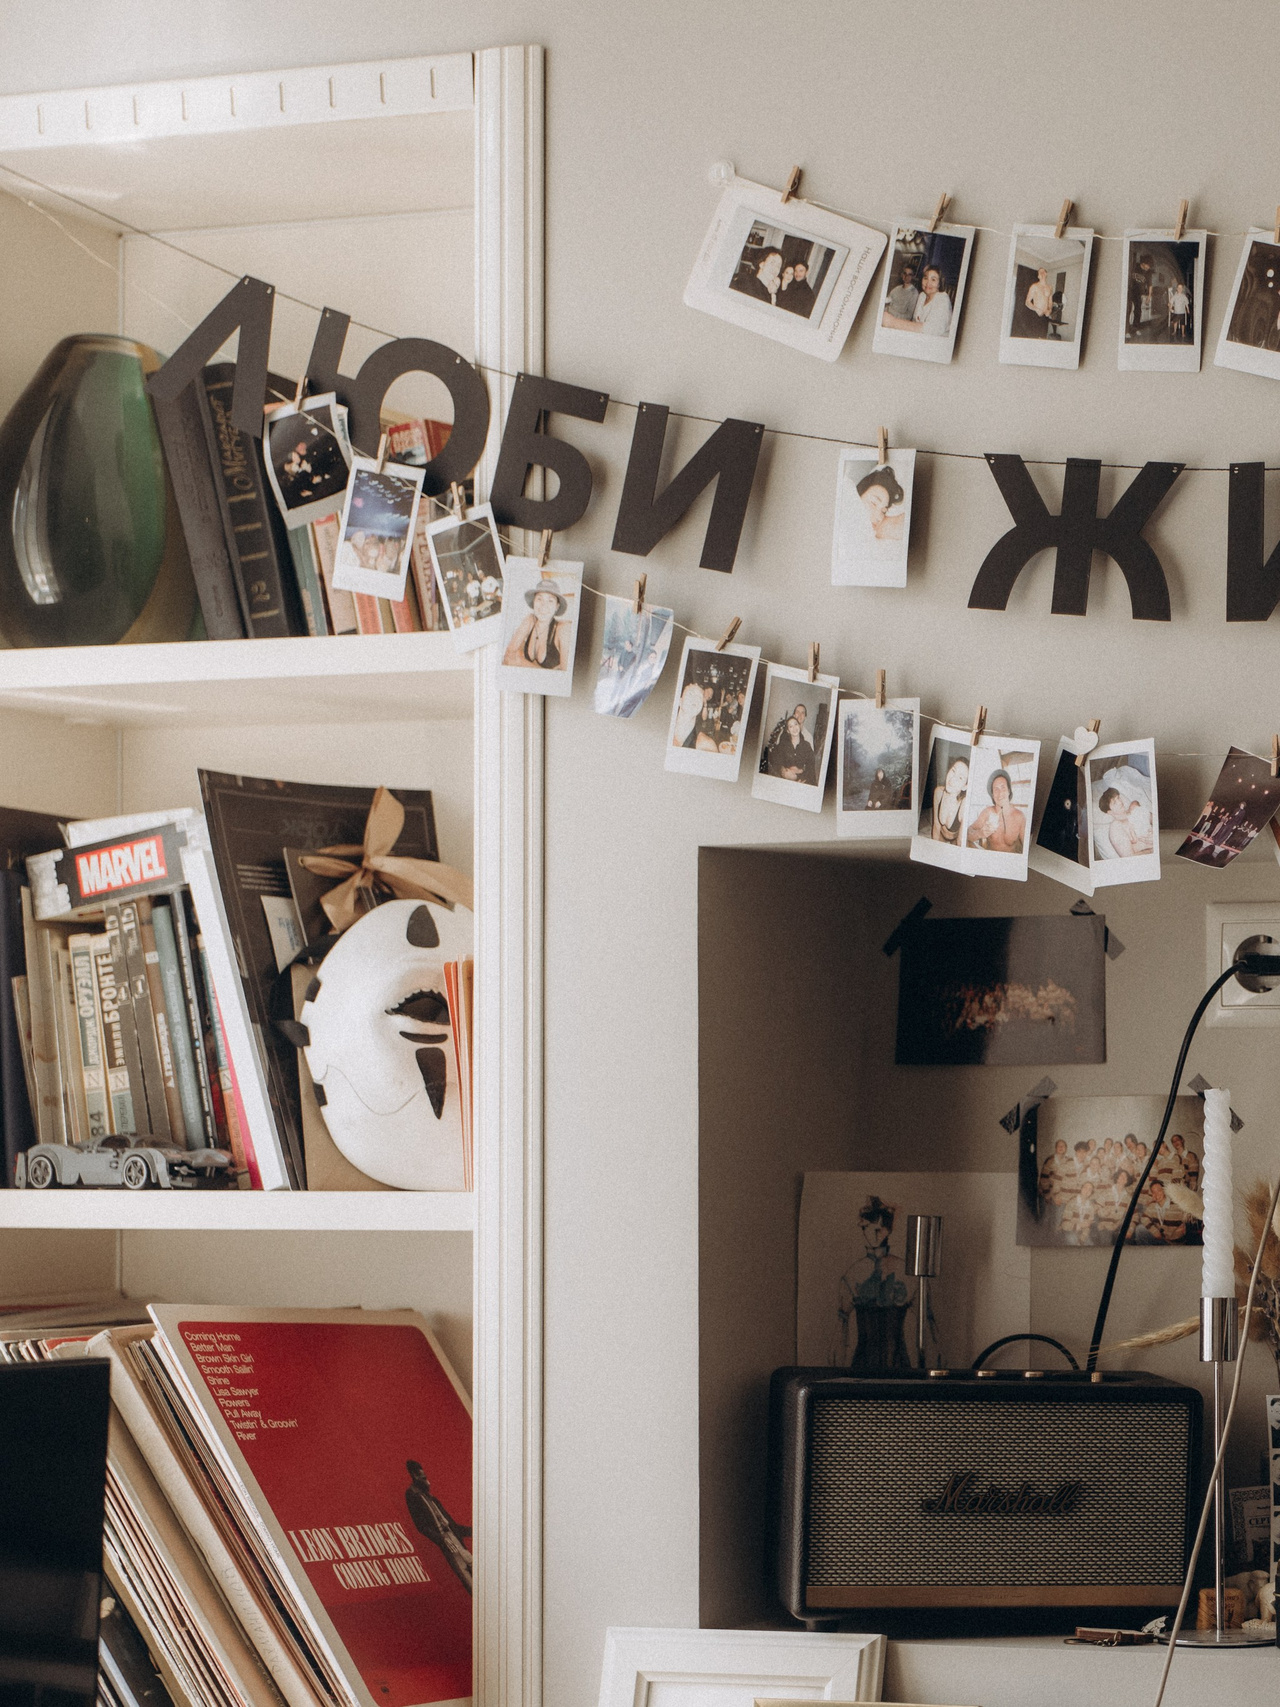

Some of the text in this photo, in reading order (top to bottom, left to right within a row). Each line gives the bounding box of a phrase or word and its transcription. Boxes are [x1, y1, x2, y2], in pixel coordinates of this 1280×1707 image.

[147, 275, 765, 574] ЛЮБИ
[76, 840, 166, 897] MARVEL
[75, 956, 95, 1017] ОРУЭЛЛ
[98, 955, 120, 1023] БРОНТЕ
[184, 1332, 242, 1343] Coming Home
[190, 1343, 235, 1352] Better Man
[195, 1353, 255, 1363] Brown Skin Girl
[201, 1365, 233, 1374] Smooth
[207, 1376, 230, 1385] Shine
[212, 1387, 259, 1398] Lisa Sawyer
[219, 1398, 250, 1407] Flowers
[224, 1409, 261, 1420] Pull Away
[259, 1420, 268, 1429] &
[236, 1431, 256, 1441] River
[922, 1471, 1082, 1514] Marshall
[288, 1522, 415, 1562] LEON BRIDGES
[332, 1555, 431, 1590] COMING HOME
